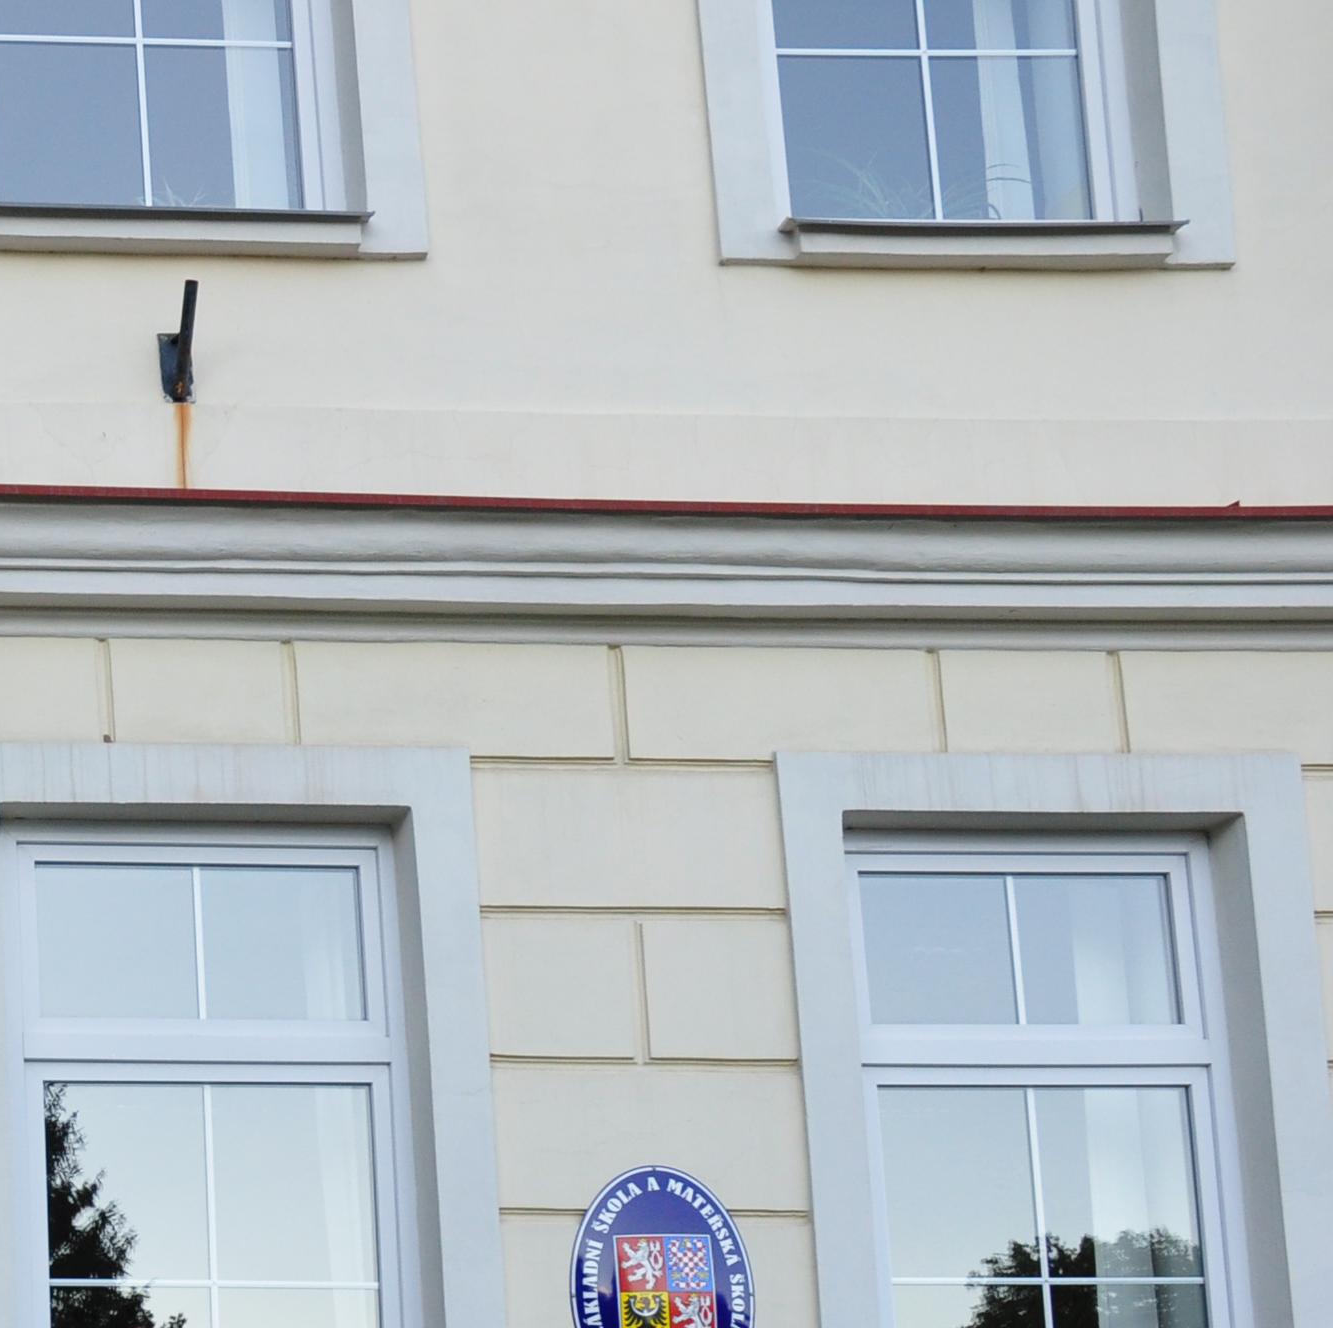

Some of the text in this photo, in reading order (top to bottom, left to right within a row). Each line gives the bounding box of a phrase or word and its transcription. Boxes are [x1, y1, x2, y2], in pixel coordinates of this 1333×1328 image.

[591, 1182, 643, 1234] ŠKOLA
[647, 1176, 660, 1191] A
[666, 1178, 739, 1266] MATEŘSKÁ
